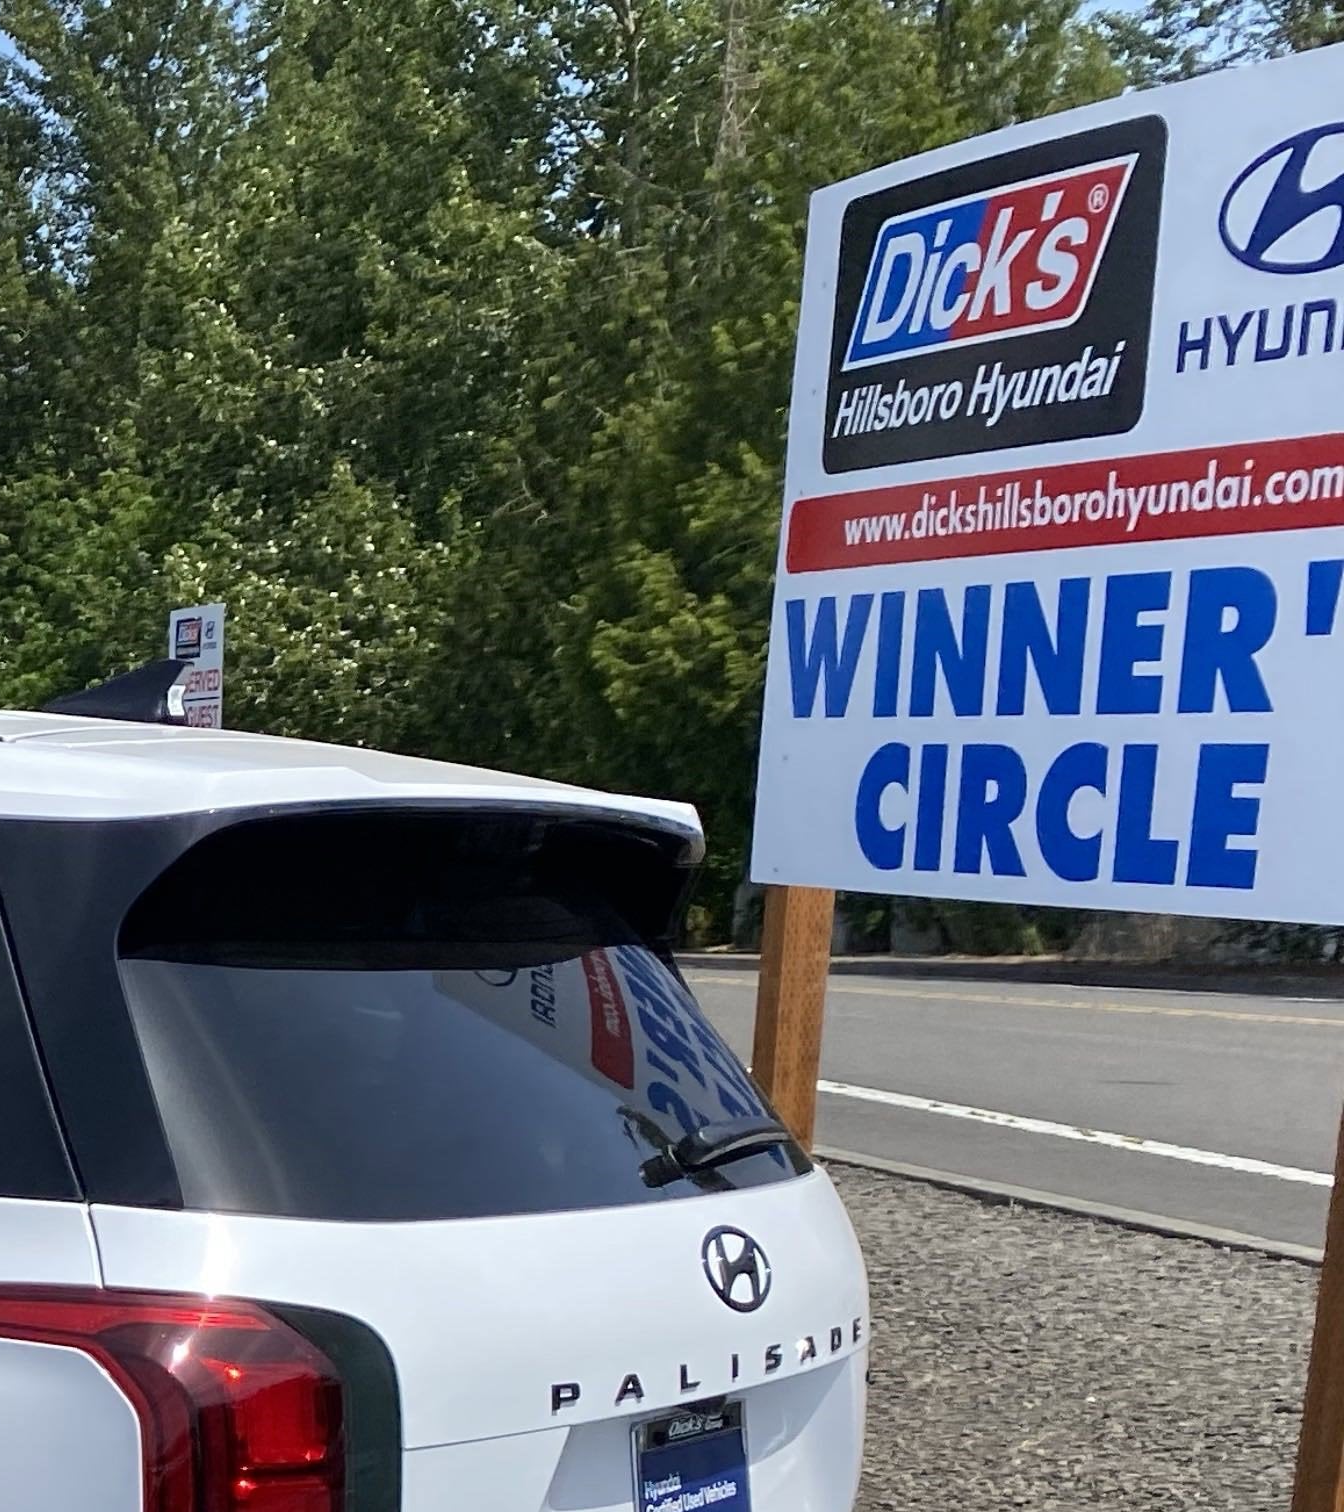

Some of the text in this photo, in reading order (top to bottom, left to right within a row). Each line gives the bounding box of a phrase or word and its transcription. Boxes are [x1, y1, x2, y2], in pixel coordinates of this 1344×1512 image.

[1176, 298, 1344, 374] HYUN
[831, 341, 1127, 439] Hillsboro Hyundai
[844, 459, 1344, 547] www.dickshillsborohyundai.com
[855, 741, 1270, 891] CIRCLE
[551, 1316, 862, 1417] PALISADE
[644, 1472, 682, 1501] Hyundai
[682, 1488, 704, 1512] Used
[703, 1480, 737, 1505] Vehicles
